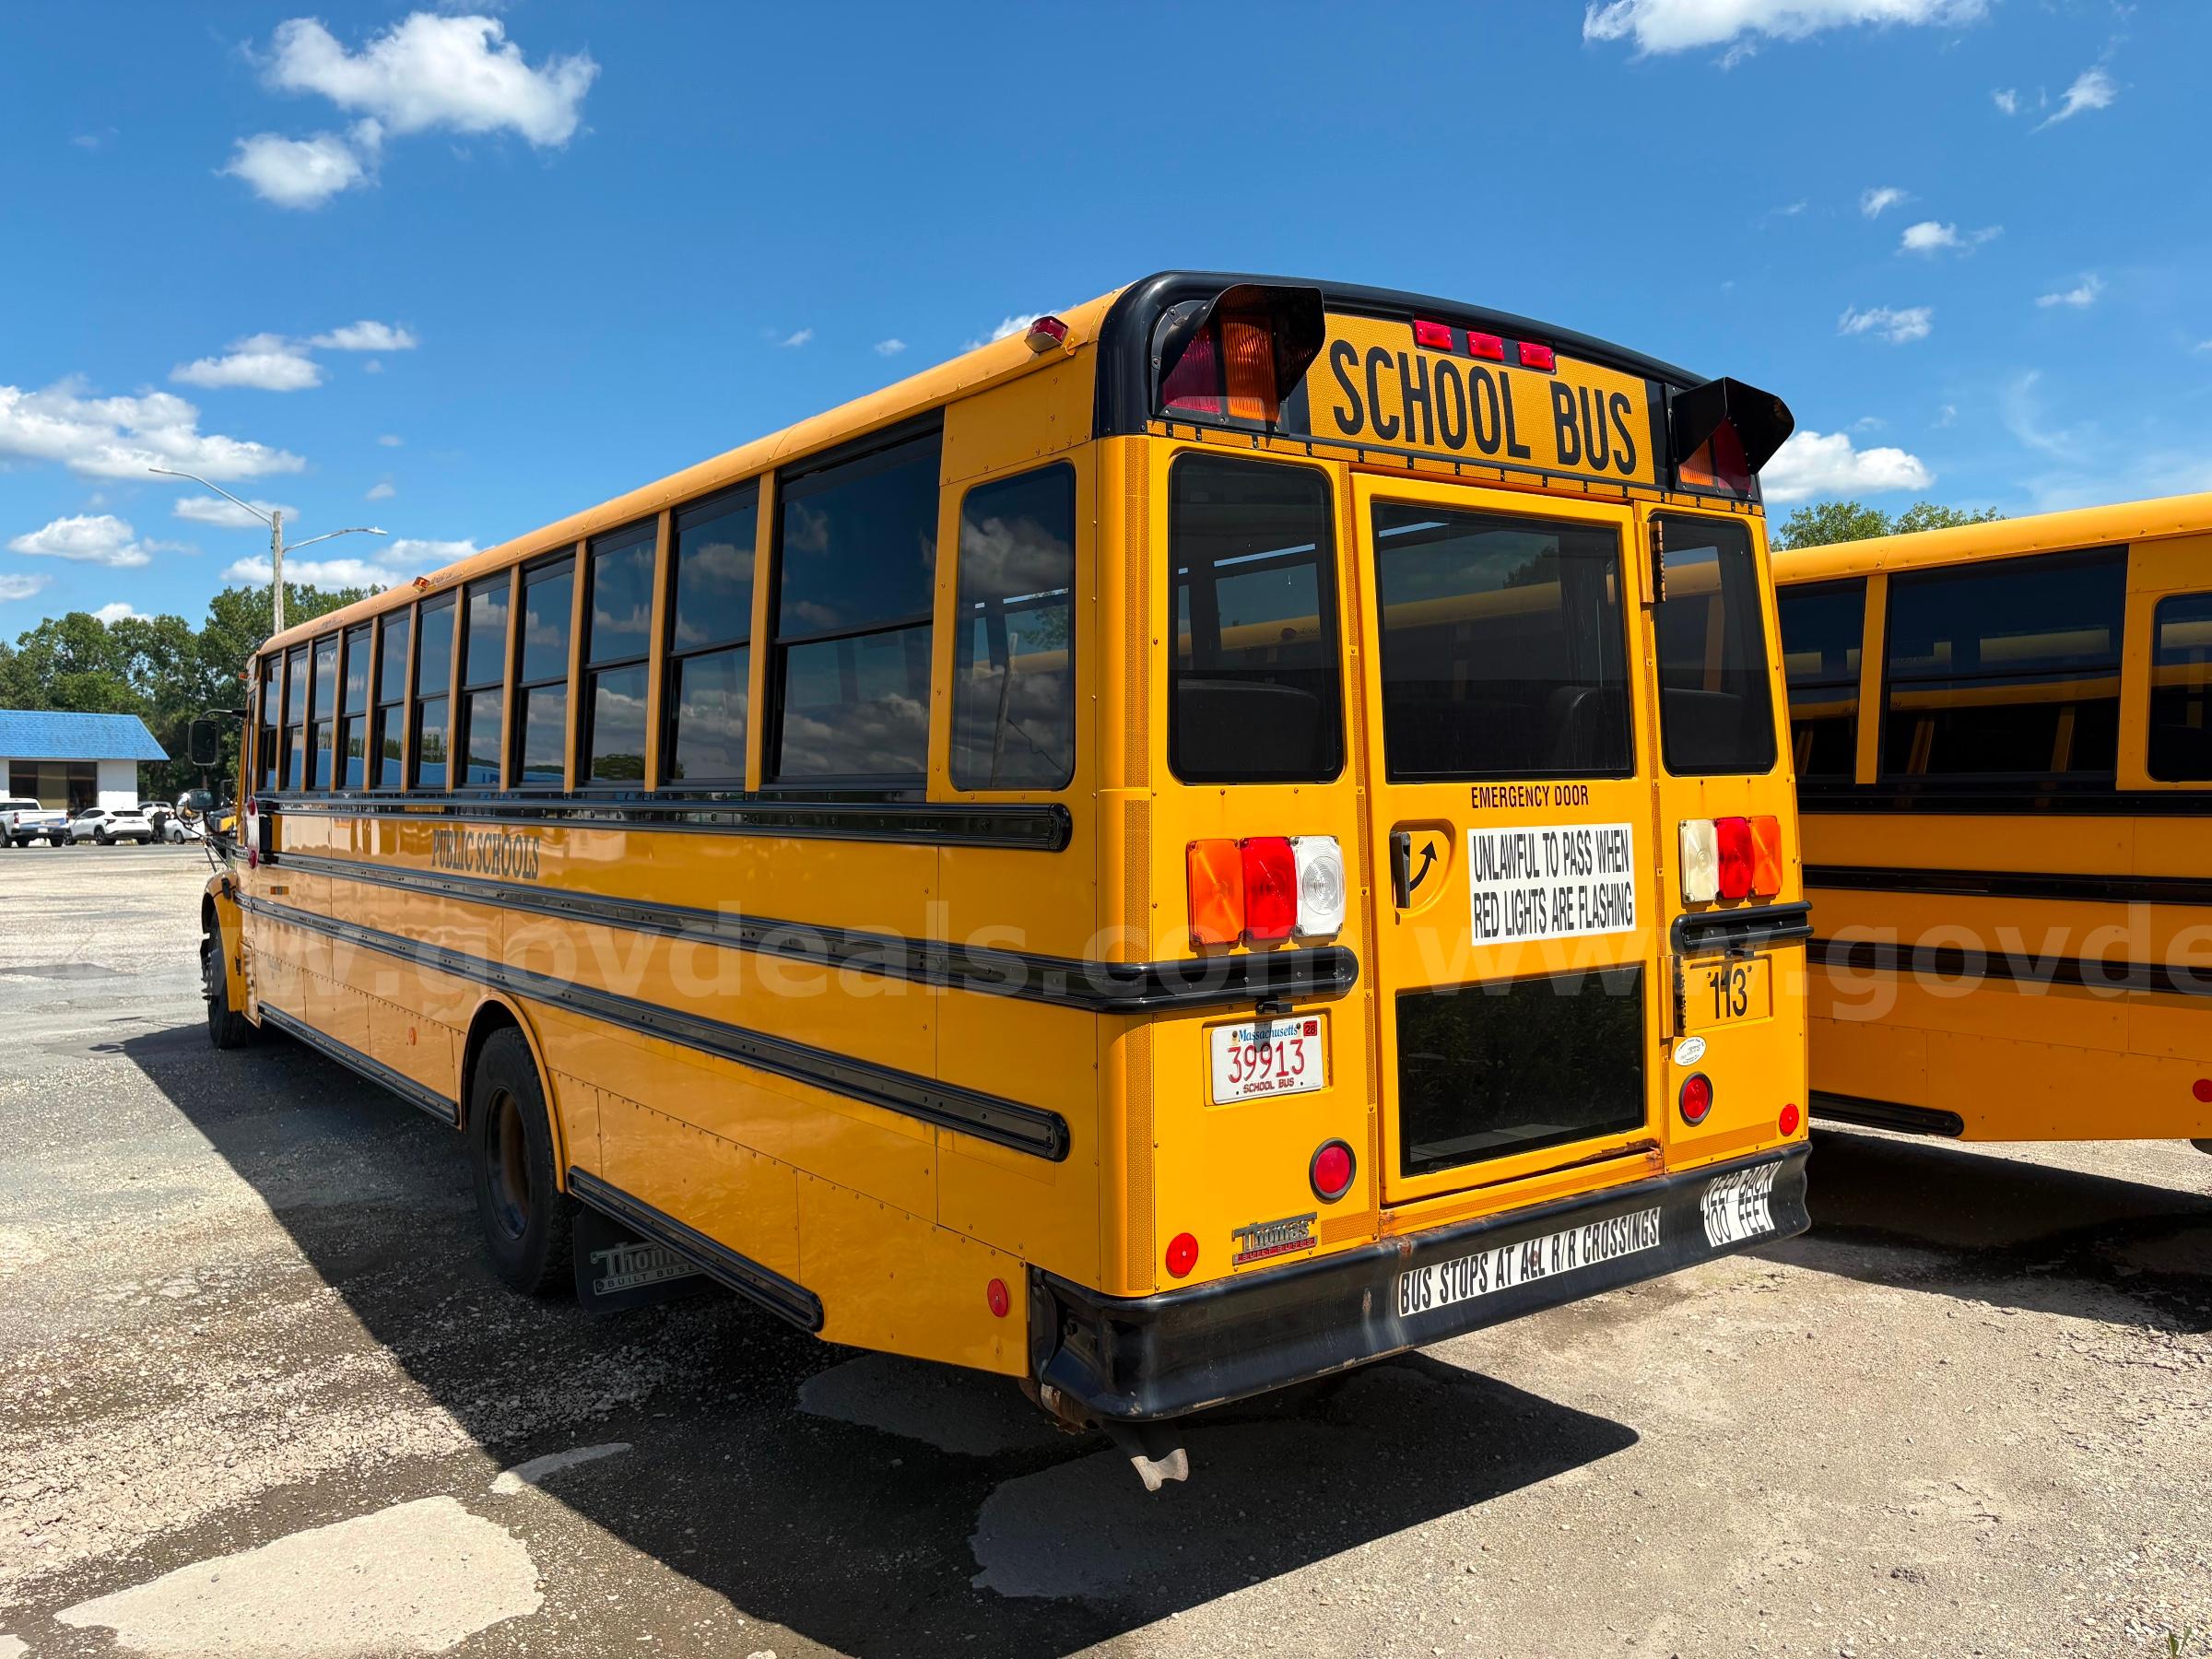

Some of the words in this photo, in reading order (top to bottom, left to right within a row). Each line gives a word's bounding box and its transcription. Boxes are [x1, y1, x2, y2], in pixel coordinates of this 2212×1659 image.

[1329, 339, 1531, 459] SCHOOL
[1549, 380, 1637, 475] BUS
[1471, 785, 1550, 808] EMERGENCY
[1554, 784, 1589, 806] DOOR
[431, 830, 475, 872] PUBLIC
[476, 832, 540, 880] SCHOOLS
[1474, 832, 1540, 882] UNLAWFUL
[1542, 831, 1559, 878] TO
[1562, 830, 1593, 876] PASS
[1595, 829, 1630, 874] WHEN
[1474, 891, 1500, 939] RED
[1504, 888, 1547, 936] LIGHTS
[1551, 886, 1575, 933] ARE
[1578, 881, 1633, 930] FLASHING
[1709, 968, 1747, 1019] 113
[1238, 1023, 1299, 1042] Massachusetts
[1227, 1038, 1305, 1084] 39913
[1242, 1080, 1276, 1094] SCHOOL
[1277, 1077, 1295, 1088] BUS
[1701, 1171, 1740, 1208] KEEP
[1738, 1161, 1782, 1198] BACK
[1231, 1212, 1317, 1253] Thomas
[1738, 1193, 1771, 1237] FEET
[590, 1241, 684, 1277] Thom
[1241, 1246, 1274, 1261] BUILT
[1277, 1238, 1314, 1253] BUSES
[1399, 1265, 1432, 1314] BUS
[1439, 1252, 1488, 1305] STOPS
[1496, 1244, 1515, 1288] AT
[1521, 1237, 1547, 1281] ALL
[1551, 1229, 1577, 1274] R/R
[1583, 1206, 1659, 1265] CROSSINGS
[606, 1273, 648, 1288] BUILT
[656, 1264, 696, 1277] BUSE
